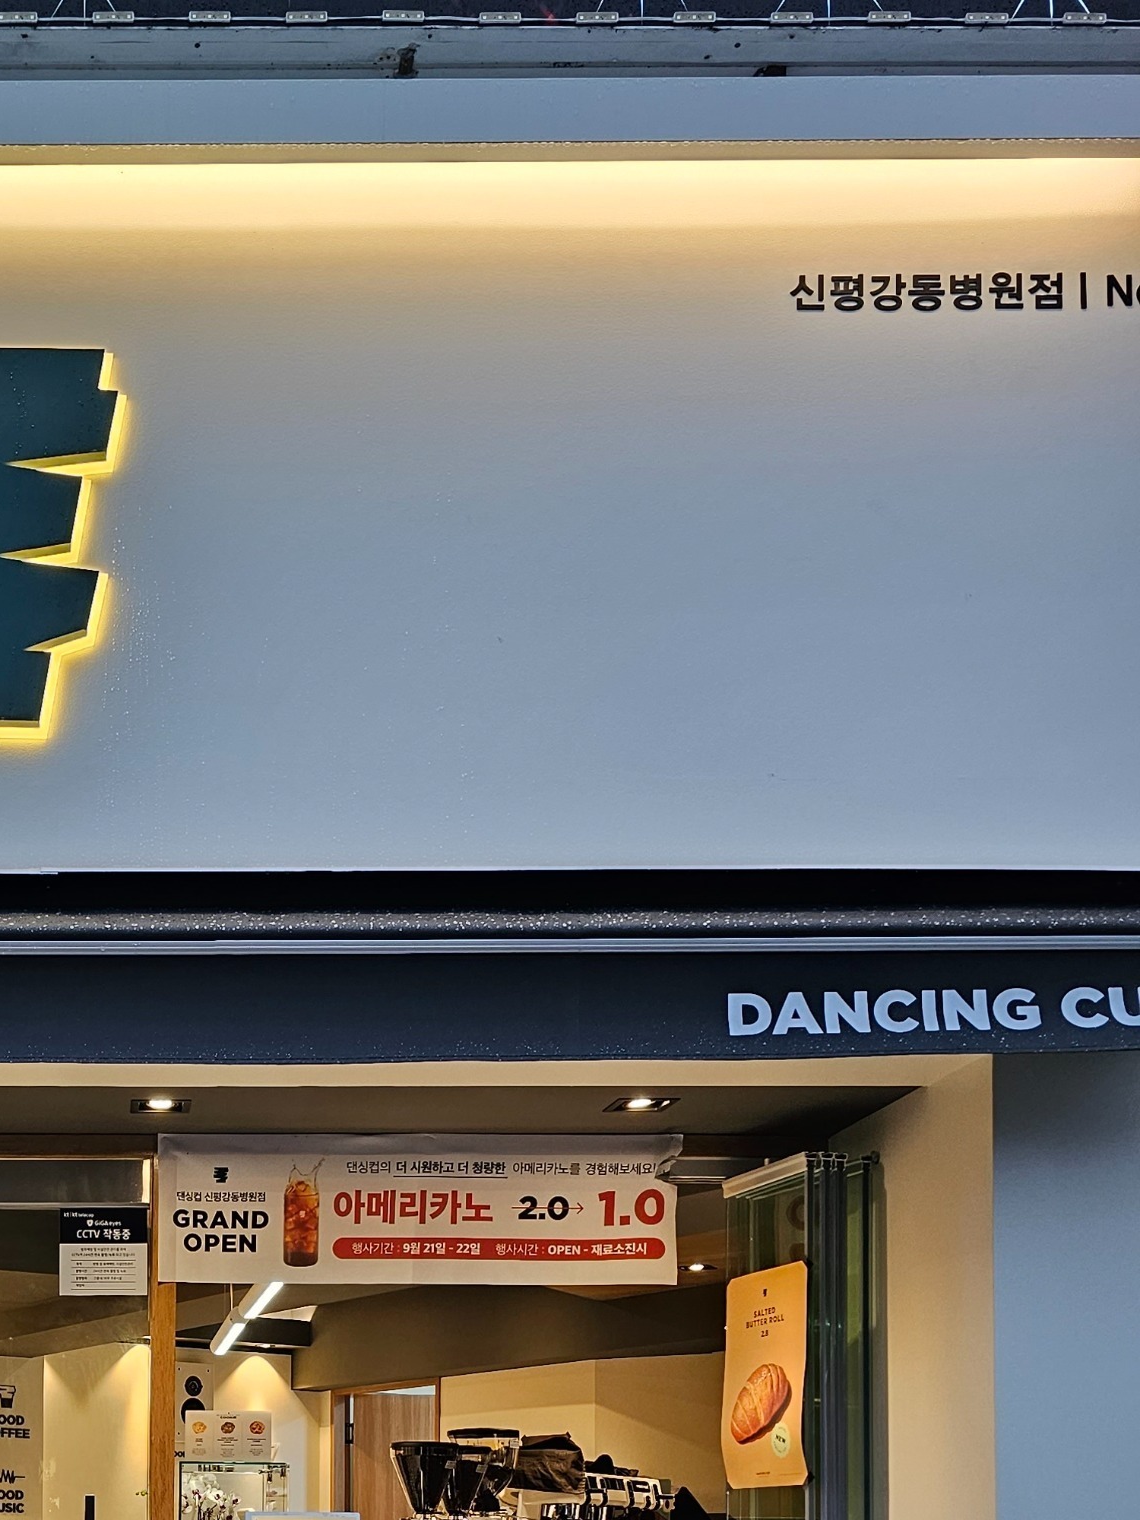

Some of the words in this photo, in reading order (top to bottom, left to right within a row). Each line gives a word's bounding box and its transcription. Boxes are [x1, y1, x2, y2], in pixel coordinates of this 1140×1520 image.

[790, 271, 1064, 311] 신평강동병원점
[727, 988, 1042, 1036] DANCING
[346, 1161, 391, 1174] 댄싱컵의
[396, 1161, 407, 1174] 더
[410, 1160, 455, 1174] 시원하고
[457, 1161, 469, 1174] 더
[471, 1161, 506, 1175] 청량한
[512, 1162, 580, 1175] 아메리카노를
[585, 1162, 657, 1175] 경험해보세요!
[176, 1191, 202, 1202] 댄싱컵
[204, 1191, 266, 1203] 신평강동병원점
[333, 1189, 494, 1225] 아메리카노
[518, 1195, 570, 1221] 2.0
[598, 1188, 665, 1227] 1.0
[172, 1209, 269, 1229] GRAND
[76, 1229, 101, 1239] CCTV
[103, 1228, 131, 1240] 작동중
[183, 1233, 257, 1253] OPEN
[351, 1242, 394, 1255] 행사기간
[402, 1242, 421, 1255] 9월
[423, 1242, 446, 1255] 21일
[455, 1242, 481, 1255] 22일
[495, 1243, 539, 1256] 행사시간
[547, 1244, 581, 1255] OPEN
[590, 1242, 647, 1255] 재료소진시
[753, 1306, 776, 1318] SALTED
[745, 1318, 768, 1329] BUTTER
[769, 1314, 784, 1323] ROLL
